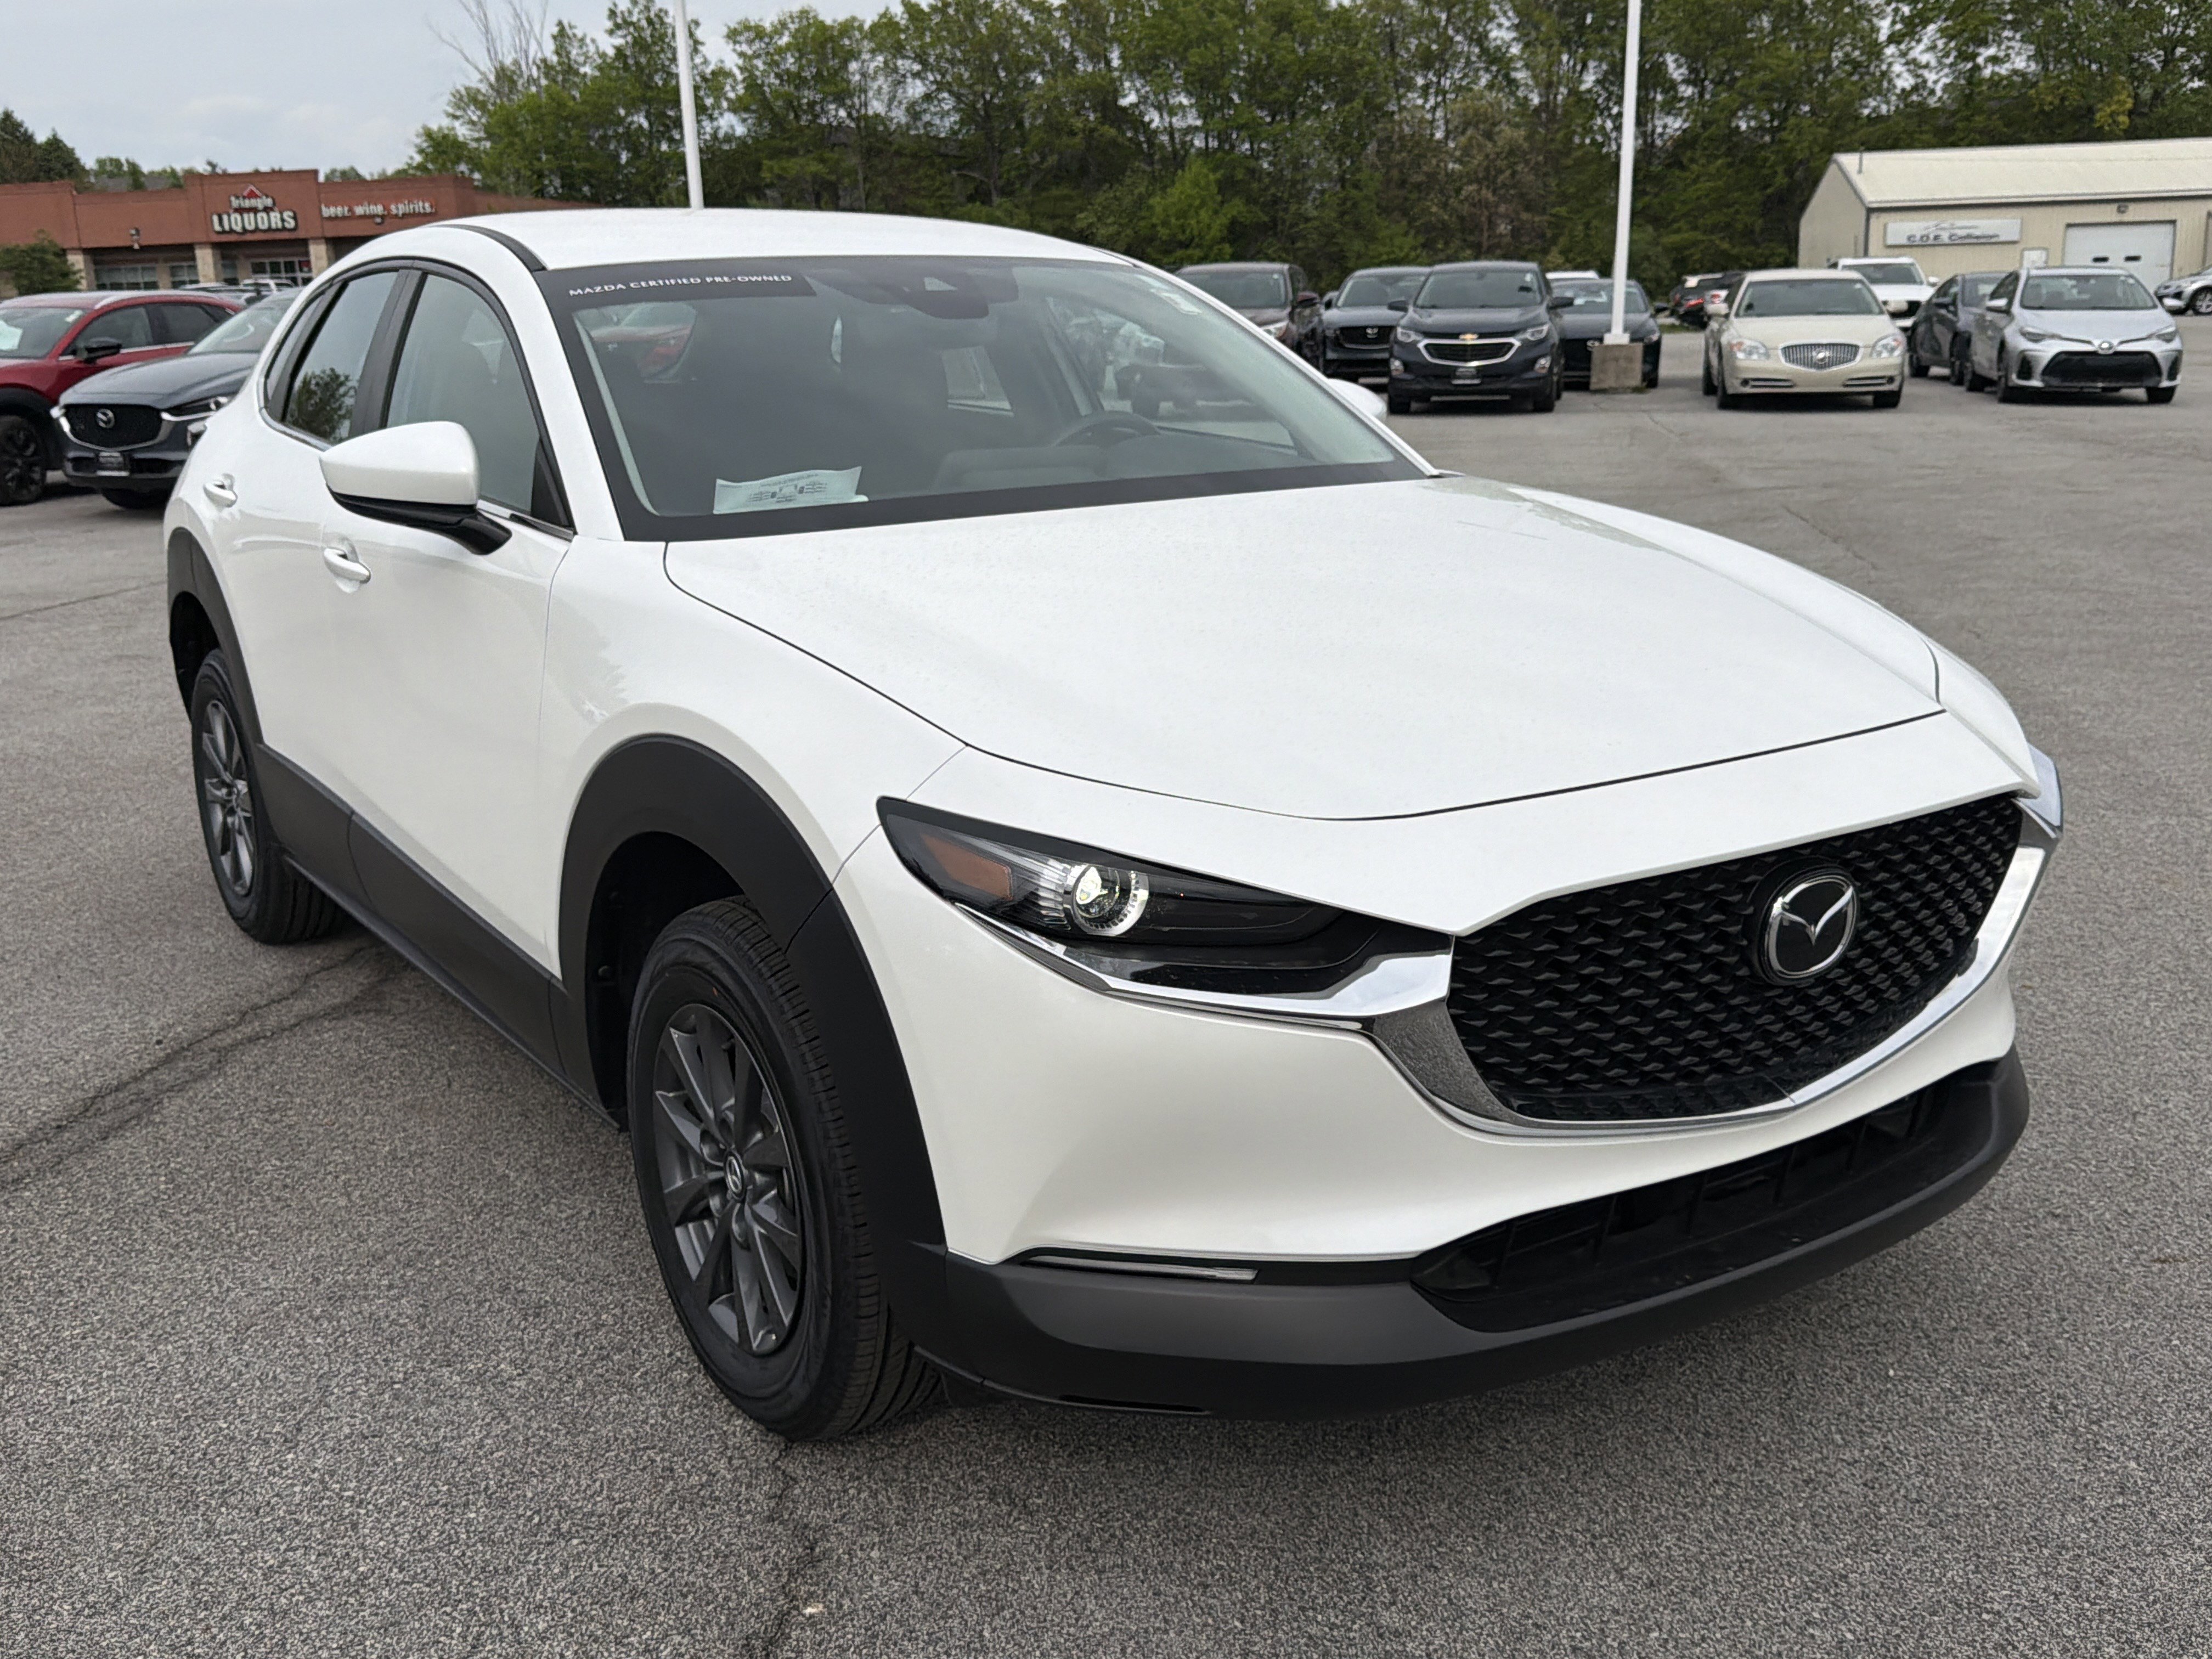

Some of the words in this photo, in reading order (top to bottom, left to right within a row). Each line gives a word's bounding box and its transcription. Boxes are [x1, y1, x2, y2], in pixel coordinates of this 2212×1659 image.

[321, 204, 351, 217] beer.
[354, 200, 387, 216] wine.
[390, 200, 435, 217] spirits.
[212, 211, 296, 233] LIQUORS
[568, 284, 627, 296] MAZDA
[629, 276, 701, 289] CERTIFIED
[706, 274, 792, 284] PRE-OWNED
